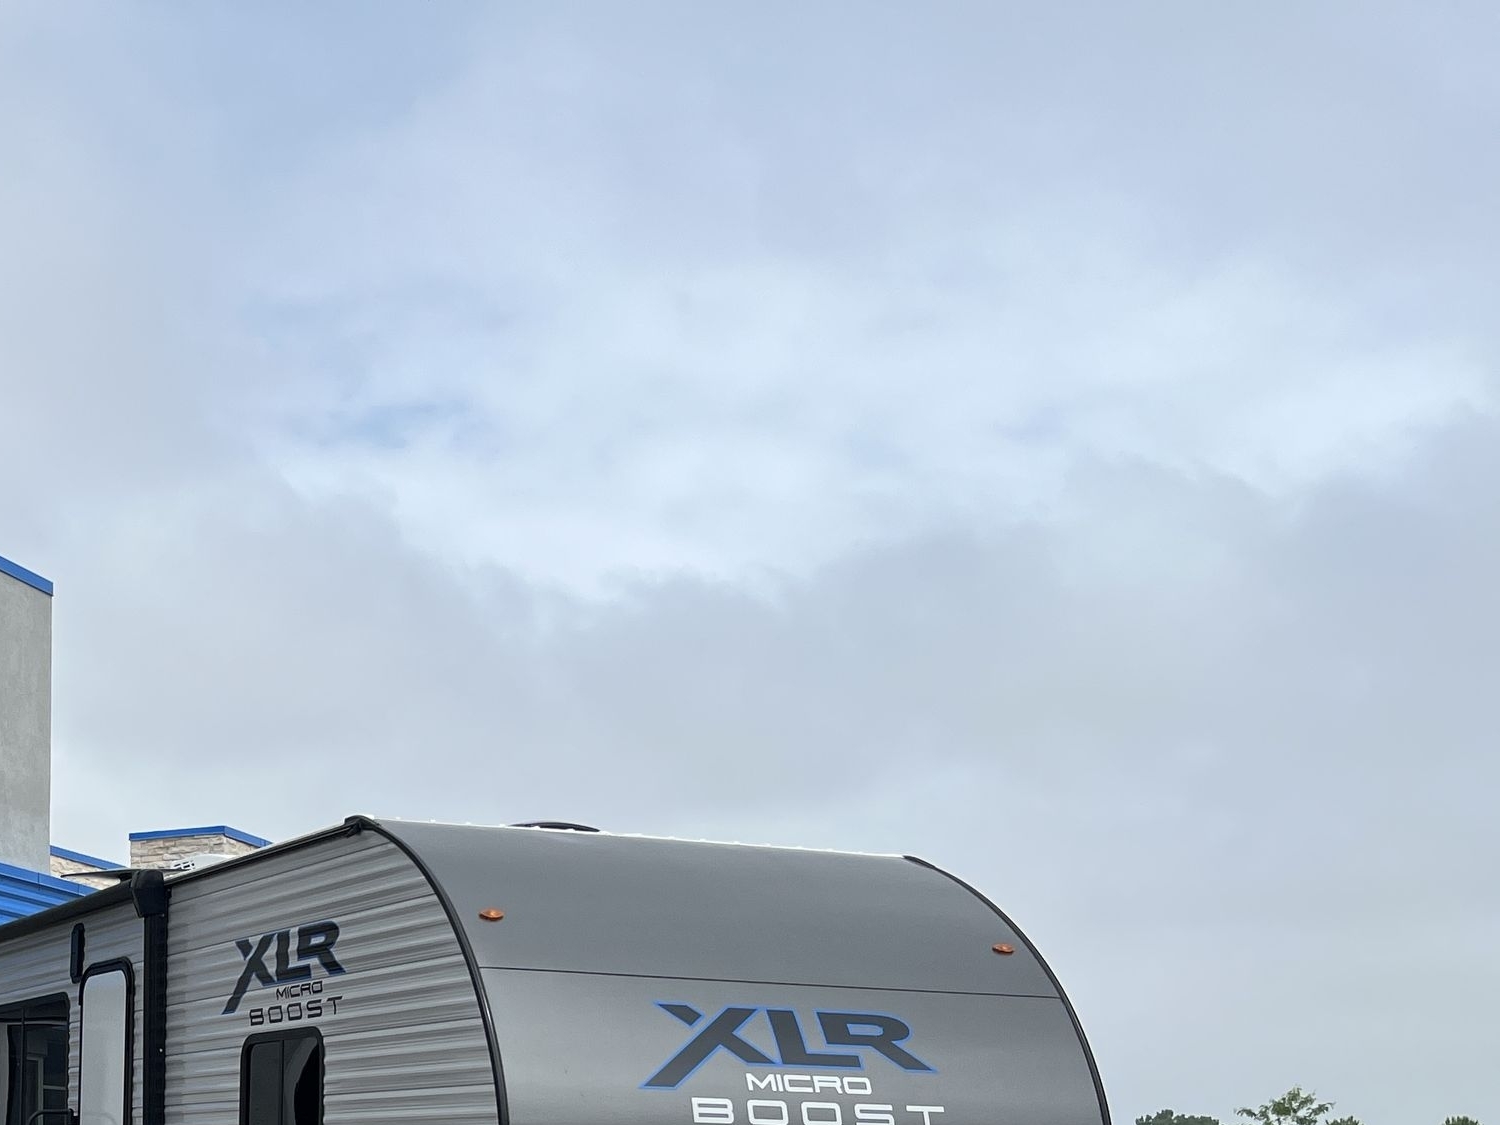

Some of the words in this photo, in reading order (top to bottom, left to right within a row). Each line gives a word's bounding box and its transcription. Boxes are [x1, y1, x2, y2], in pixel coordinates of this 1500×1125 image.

[221, 920, 346, 1015] XLR
[275, 980, 324, 1000] MICRO
[249, 995, 343, 1026] BOOST
[638, 1001, 939, 1090] XLR
[745, 1073, 873, 1095] MICRO
